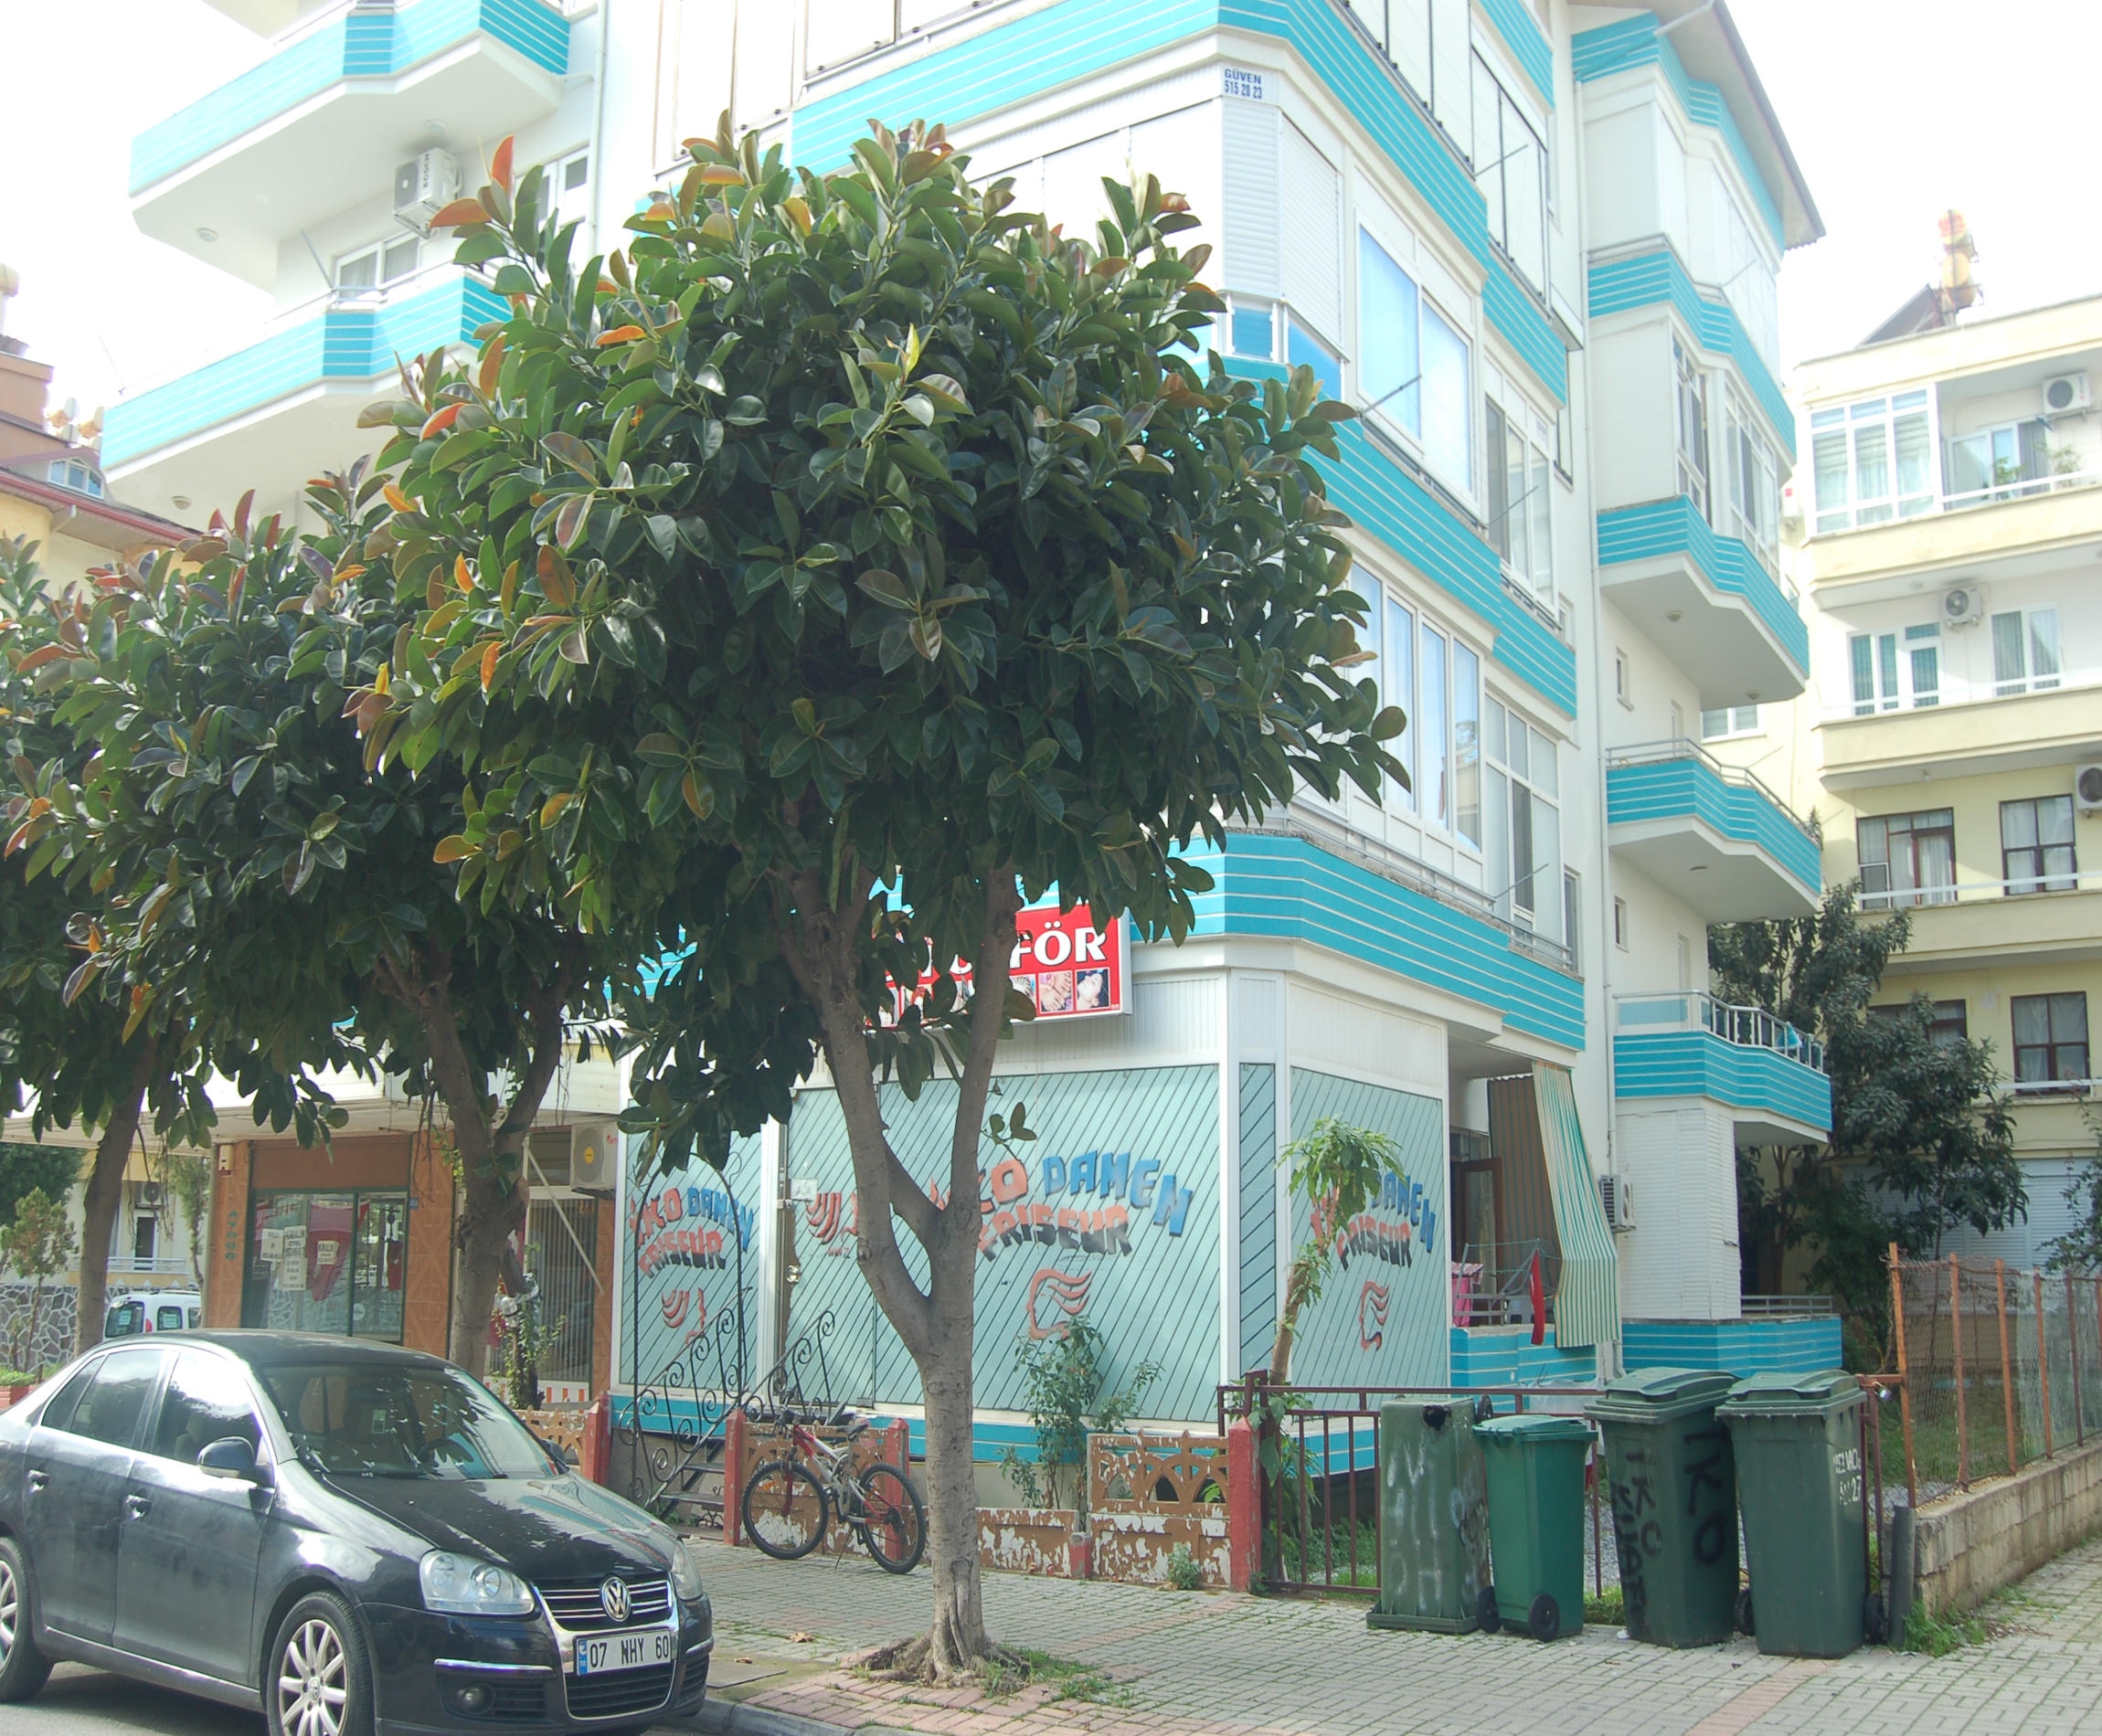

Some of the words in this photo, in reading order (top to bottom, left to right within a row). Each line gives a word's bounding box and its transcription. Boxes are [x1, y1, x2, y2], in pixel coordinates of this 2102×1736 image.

[1225, 68, 1261, 84] GÜVEN
[1043, 1149, 1193, 1237] DAMEN
[638, 1225, 727, 1278] FRISEUR
[978, 1203, 1133, 1262] FRISEUR
[589, 1642, 608, 1668] 07
[621, 1637, 644, 1665] NHY
[655, 1635, 669, 1660] 60
